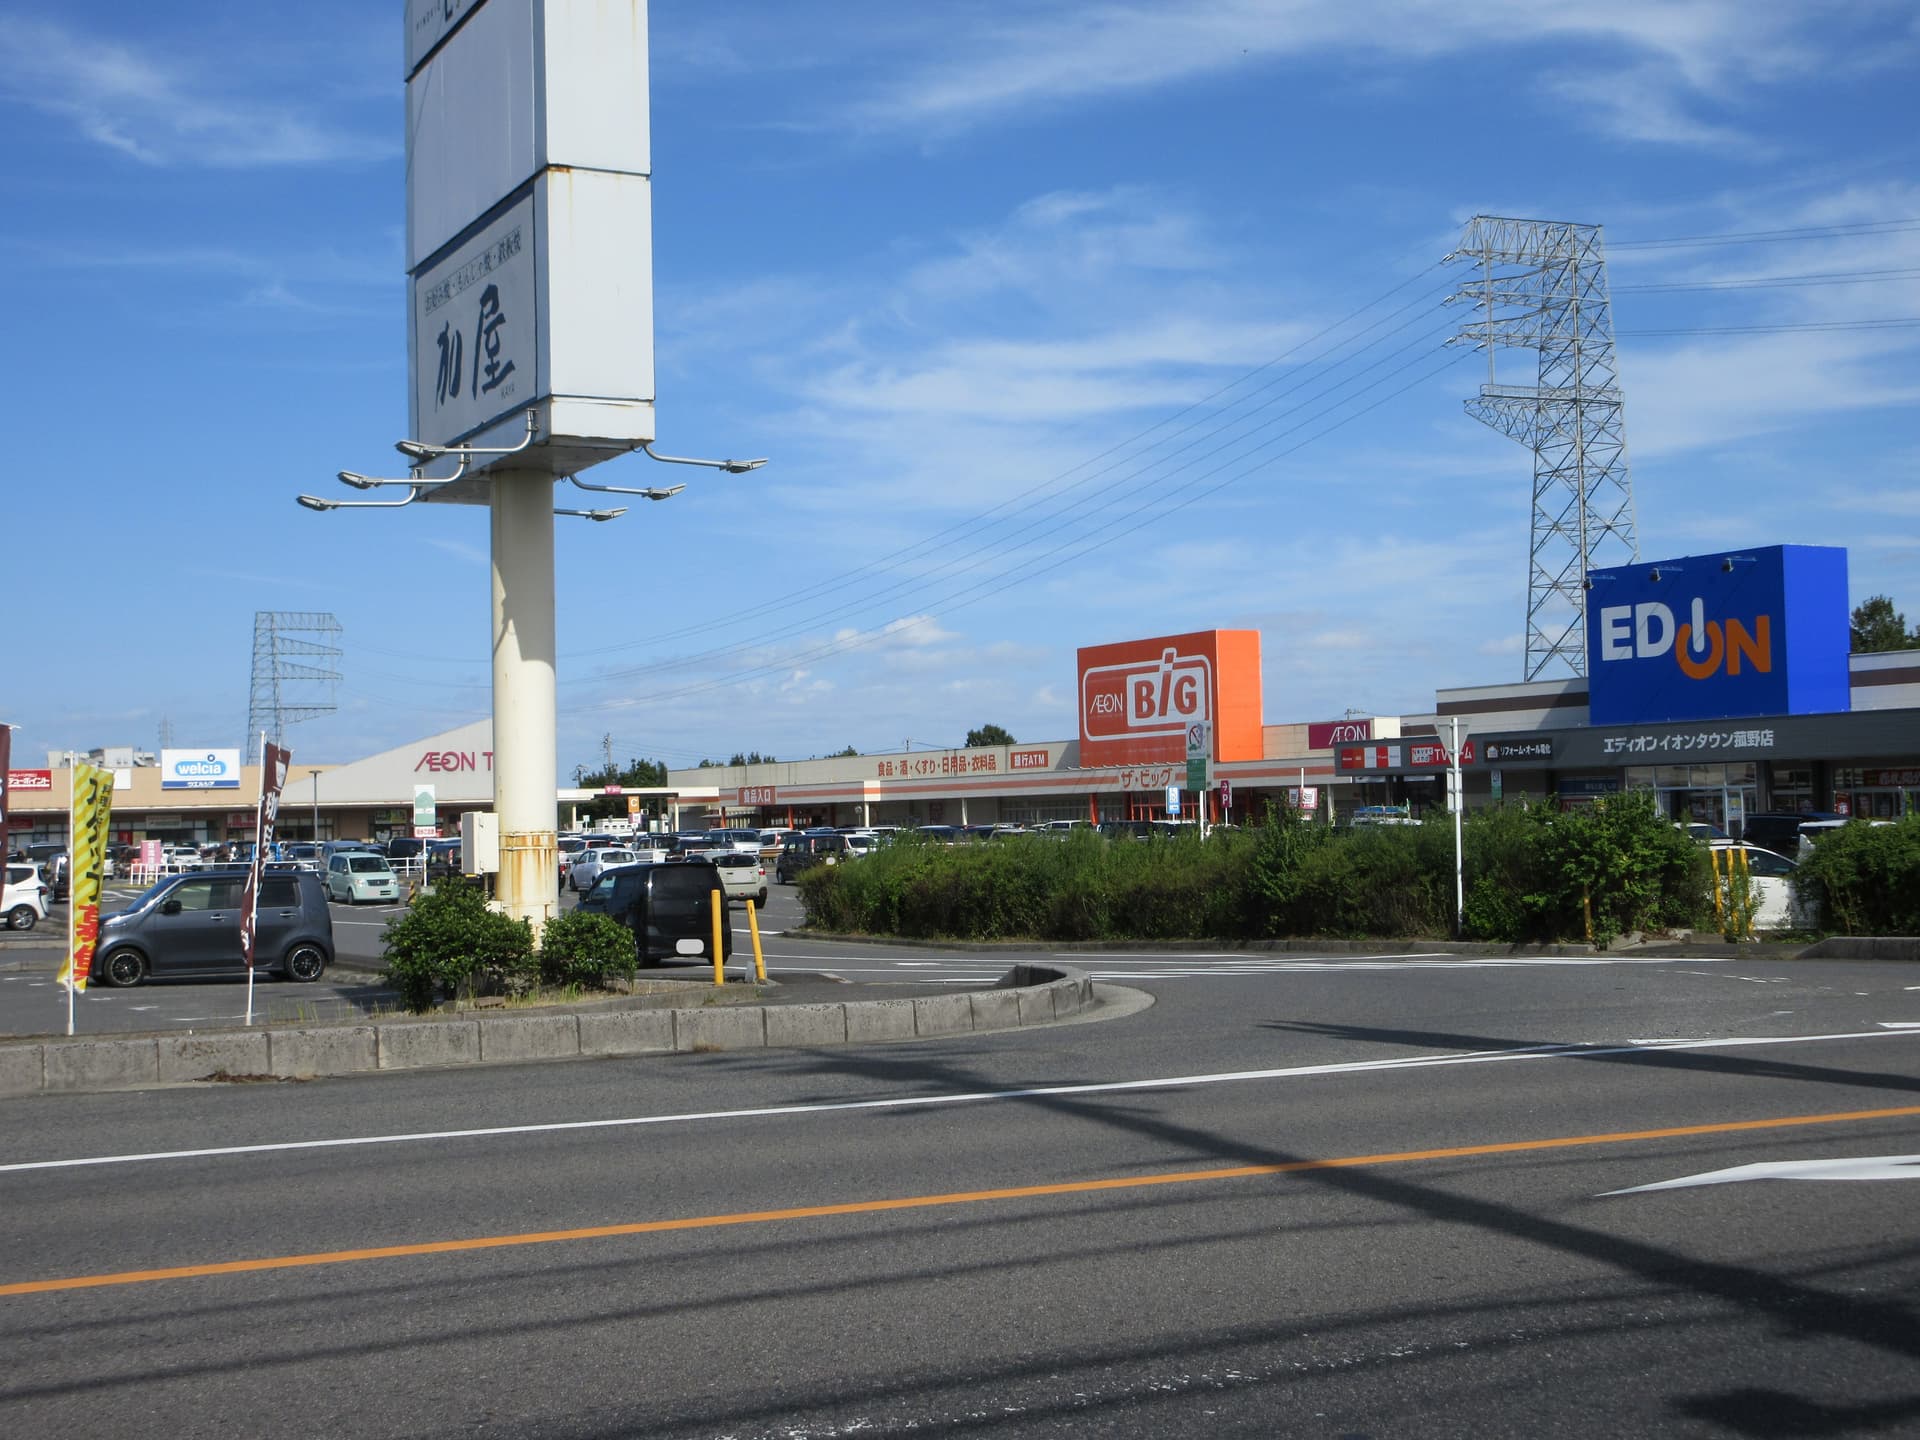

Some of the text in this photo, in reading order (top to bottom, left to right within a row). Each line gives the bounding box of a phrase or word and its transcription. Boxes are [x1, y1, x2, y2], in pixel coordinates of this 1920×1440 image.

[1600, 597, 1772, 680] EDION
[178, 757, 221, 774] welcia
[877, 754, 997, 777] 食品・酒・くすり・日用品・衣料品
[1121, 767, 1173, 788] ザ・ビッグ
[1222, 794, 1229, 804] P
